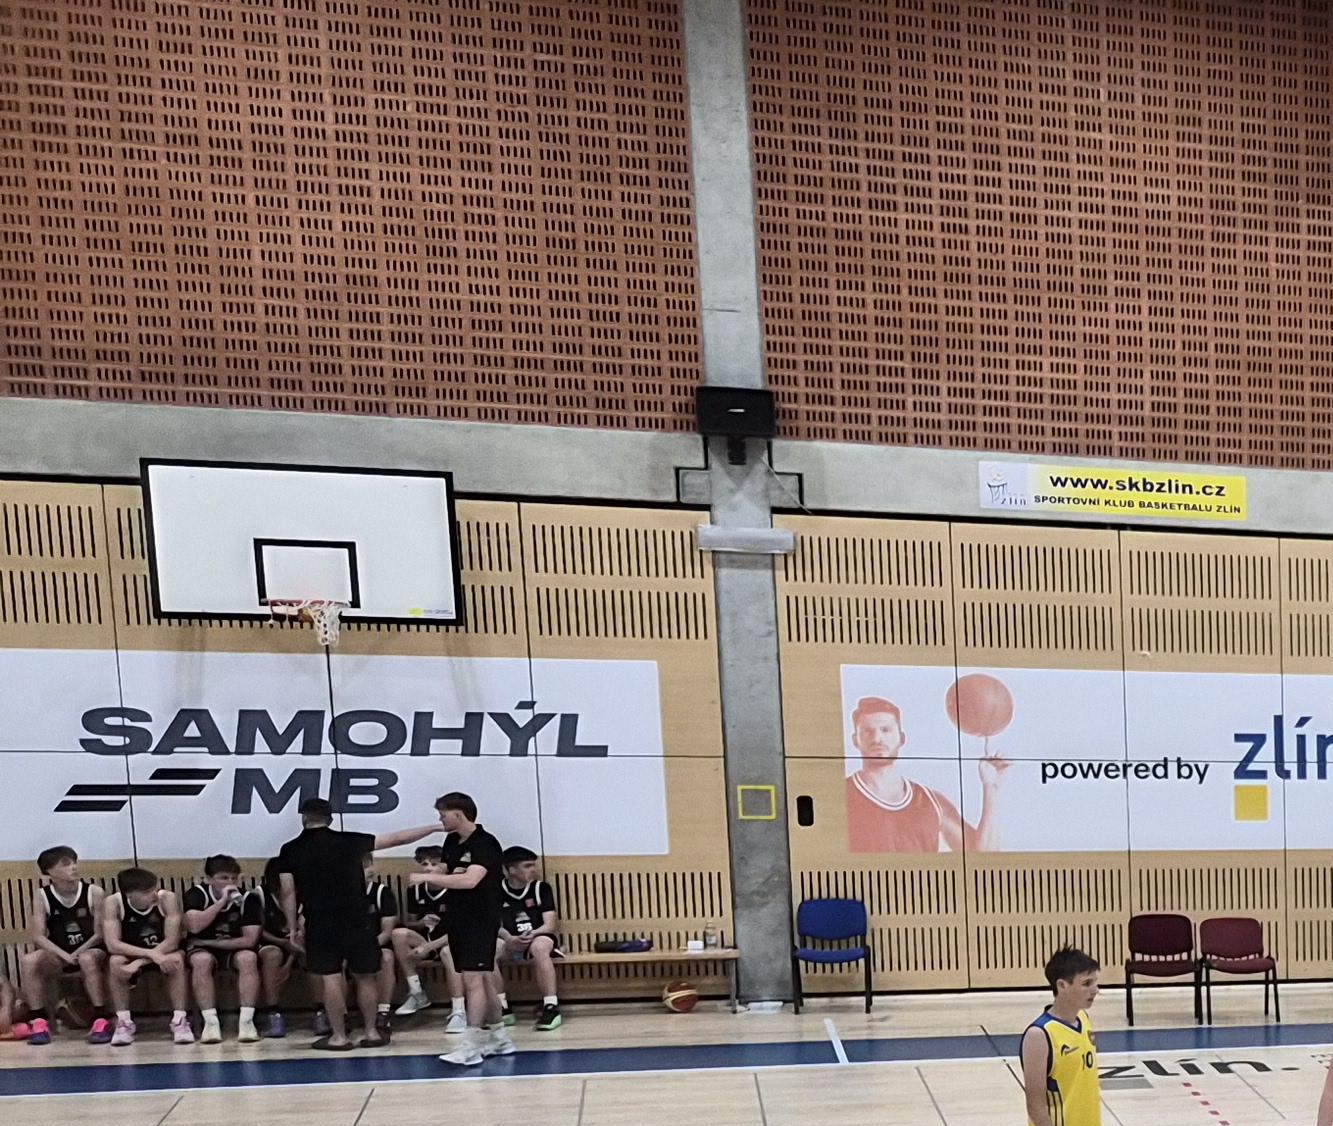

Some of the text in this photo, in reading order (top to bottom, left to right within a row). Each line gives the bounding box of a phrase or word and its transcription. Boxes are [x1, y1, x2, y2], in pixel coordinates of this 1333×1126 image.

[1049, 475, 1227, 497] www.skbzlin.cz
[1034, 494, 1241, 514] SPORTOVNÍ KLUB BASKETBALU ZLÍN
[78, 700, 610, 757] SAMOHÝL
[1041, 756, 1169, 785] powered
[1176, 756, 1211, 785] by
[230, 768, 401, 815] MB
[1081, 1050, 1094, 1071] 10
